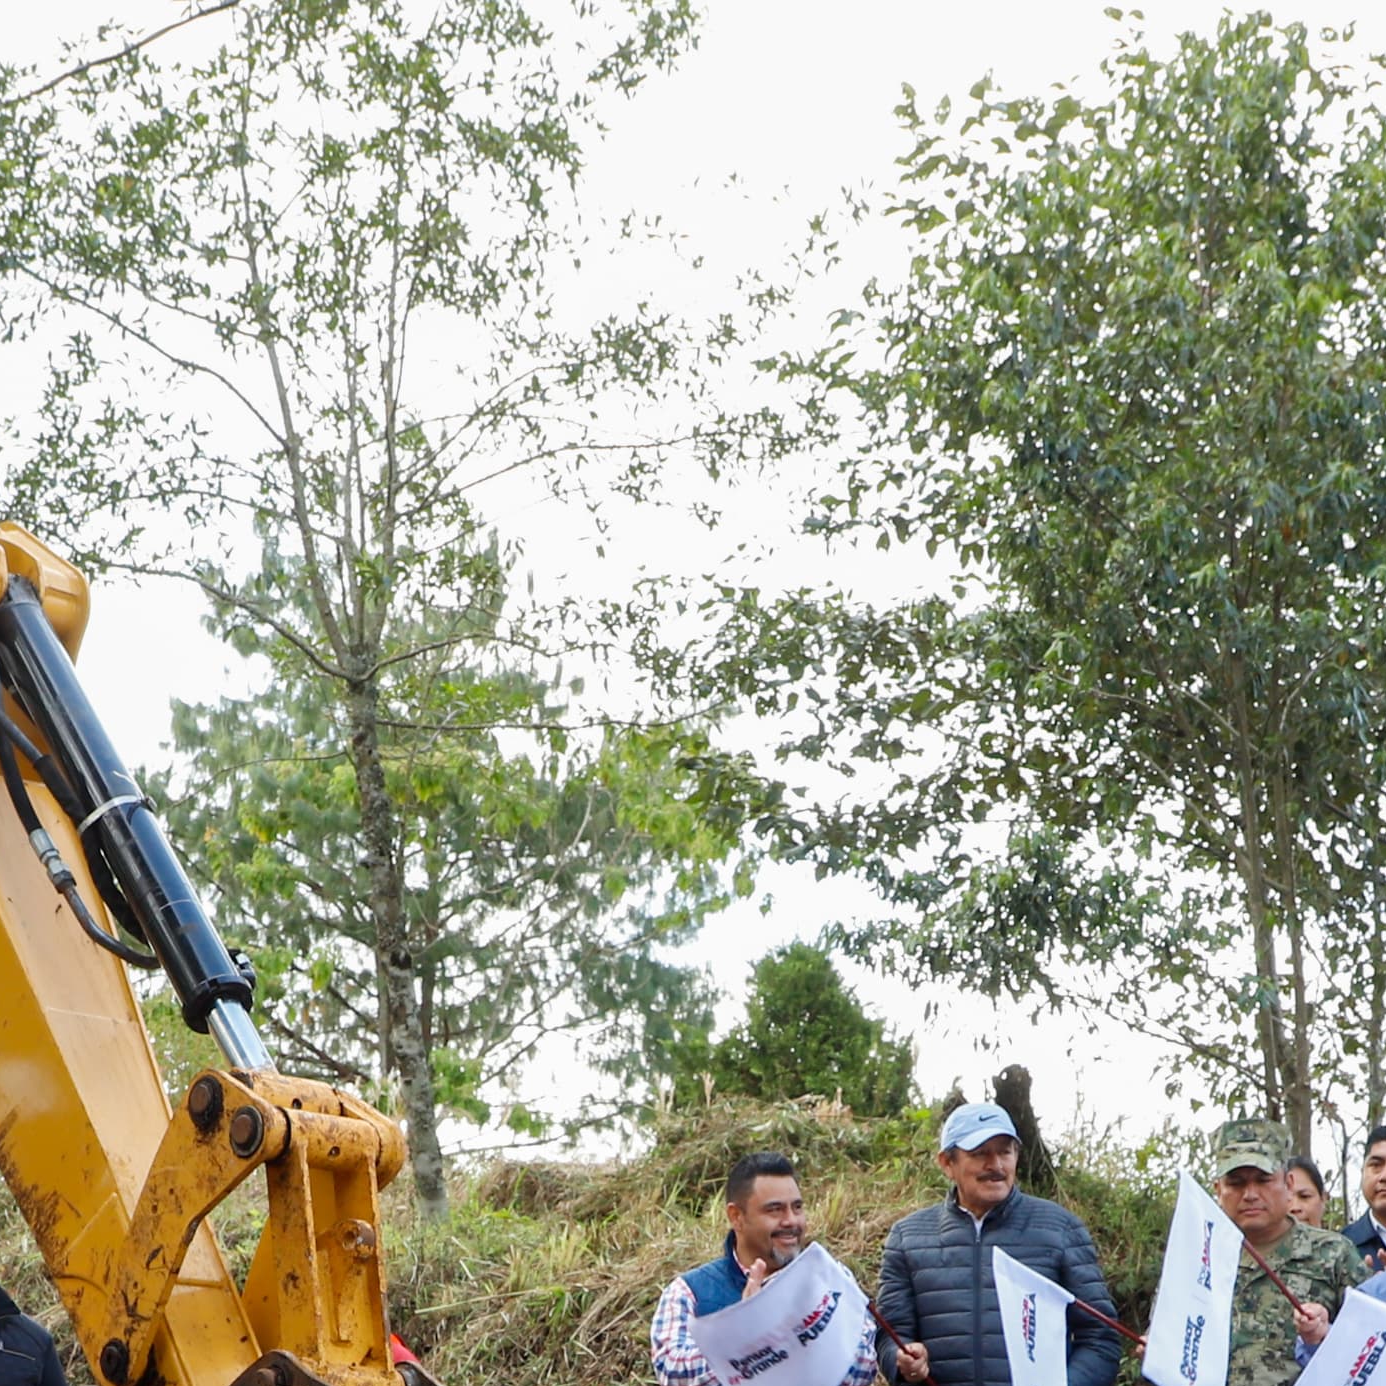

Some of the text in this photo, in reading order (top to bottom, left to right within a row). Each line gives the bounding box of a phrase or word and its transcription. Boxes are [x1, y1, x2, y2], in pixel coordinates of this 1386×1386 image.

[797, 1291, 842, 1347] PUEBLA
[729, 1345, 774, 1371] Pensar
[741, 1349, 789, 1380] Grande
[1180, 1316, 1195, 1379] Pensar
[1188, 1314, 1206, 1382] Grande
[1349, 1335, 1378, 1378] AMOR
